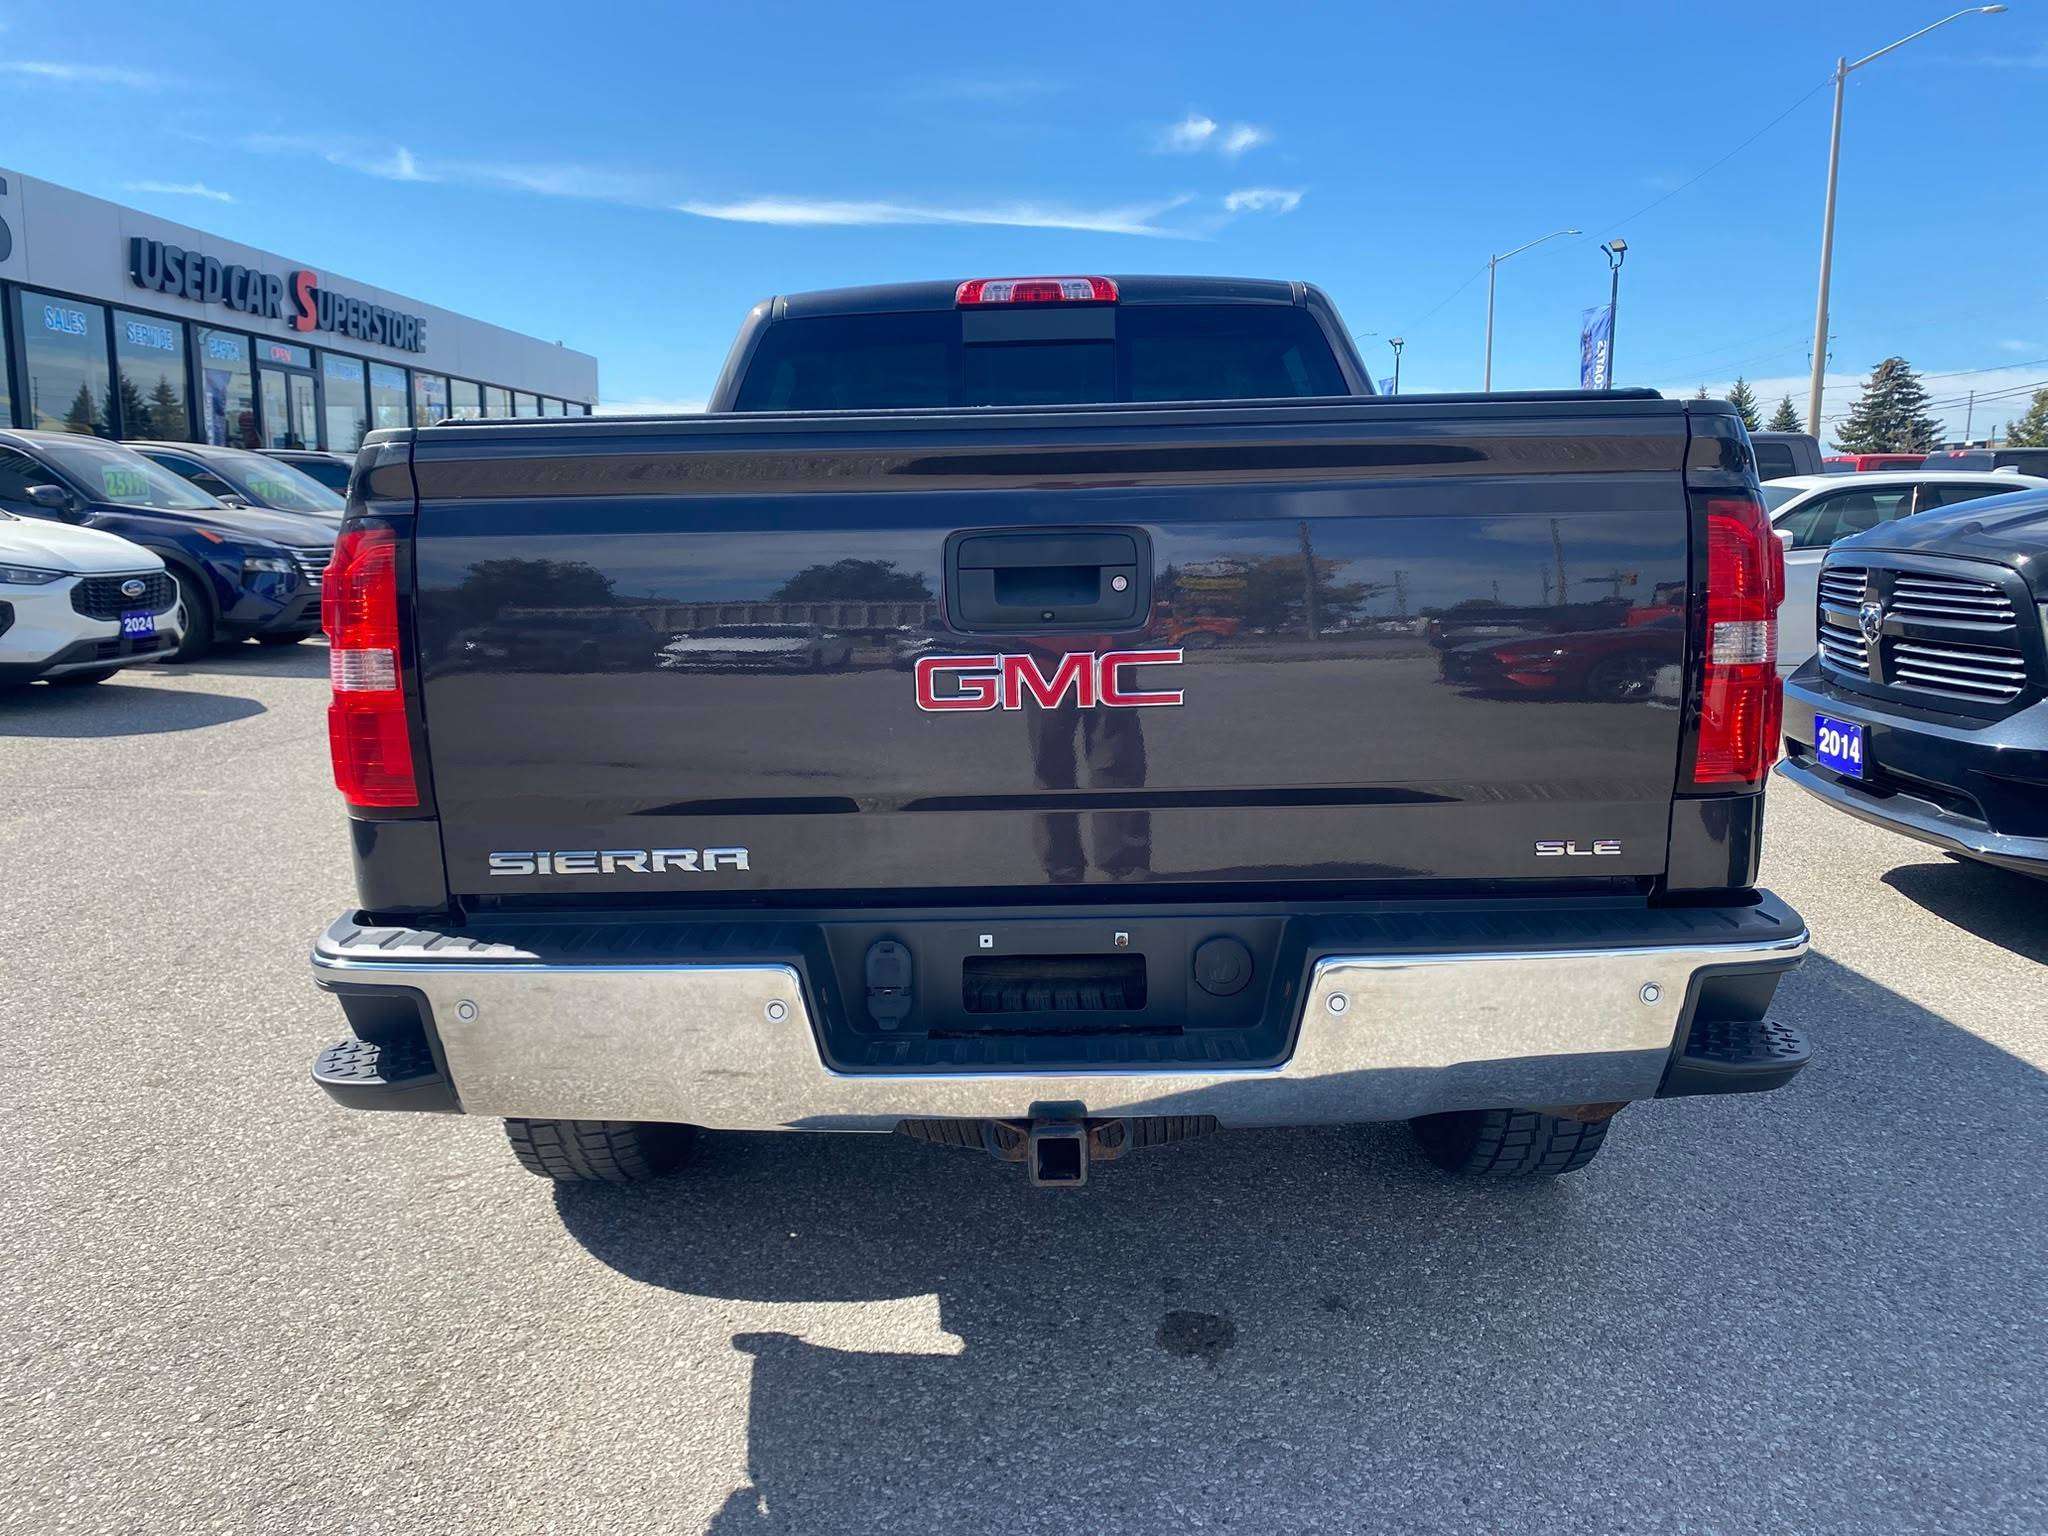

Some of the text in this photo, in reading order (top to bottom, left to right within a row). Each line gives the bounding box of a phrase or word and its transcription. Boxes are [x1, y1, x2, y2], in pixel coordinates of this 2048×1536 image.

[130, 237, 427, 353] USED CAR SUPERSTORE
[44, 304, 87, 336] SALES
[124, 615, 154, 633] 2024
[915, 648, 1185, 711] GMC
[1818, 726, 1860, 764] 2014
[488, 847, 750, 876] SIERRA
[1535, 840, 1622, 856] SLE
